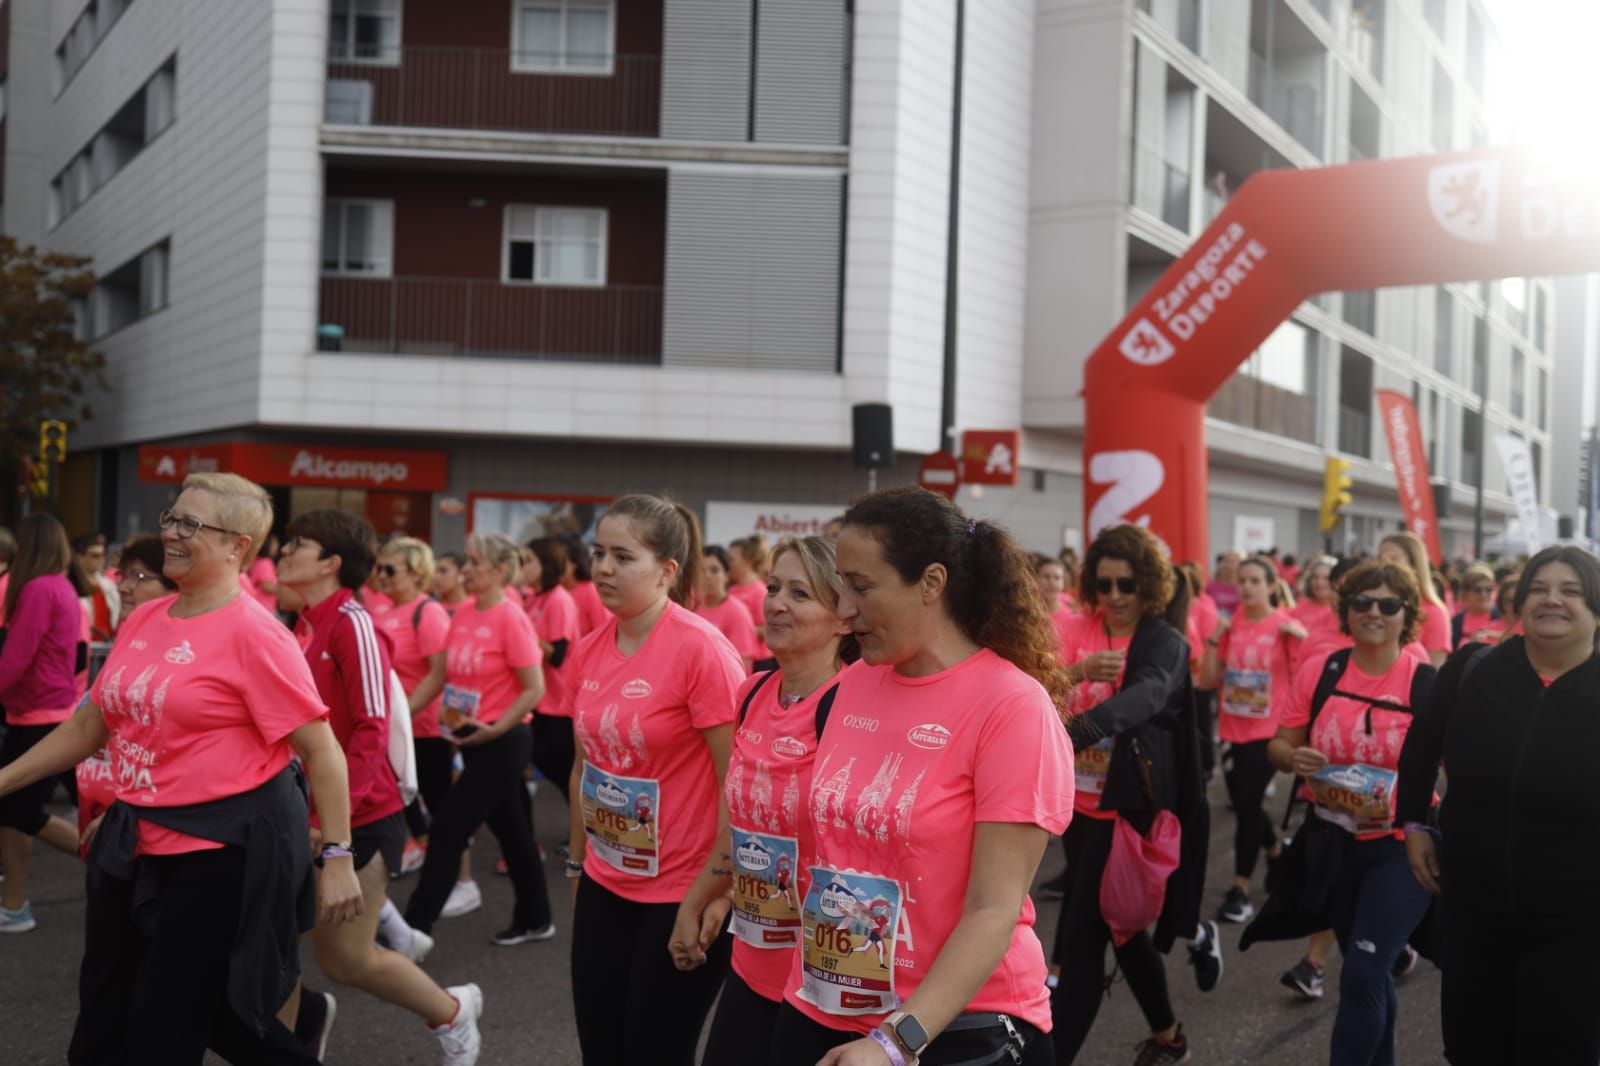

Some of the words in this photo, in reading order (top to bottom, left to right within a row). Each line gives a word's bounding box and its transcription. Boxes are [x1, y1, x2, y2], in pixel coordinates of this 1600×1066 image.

[1152, 222, 1245, 321] Zaragoza
[1168, 239, 1267, 342] DEPORTE
[290, 451, 408, 482] Alcampo
[843, 714, 879, 733] OYSHO
[596, 808, 627, 832] 016
[739, 875, 768, 899] 016
[816, 923, 851, 954] 016
[821, 955, 838, 971] 1897
[838, 975, 862, 987] MUJER
